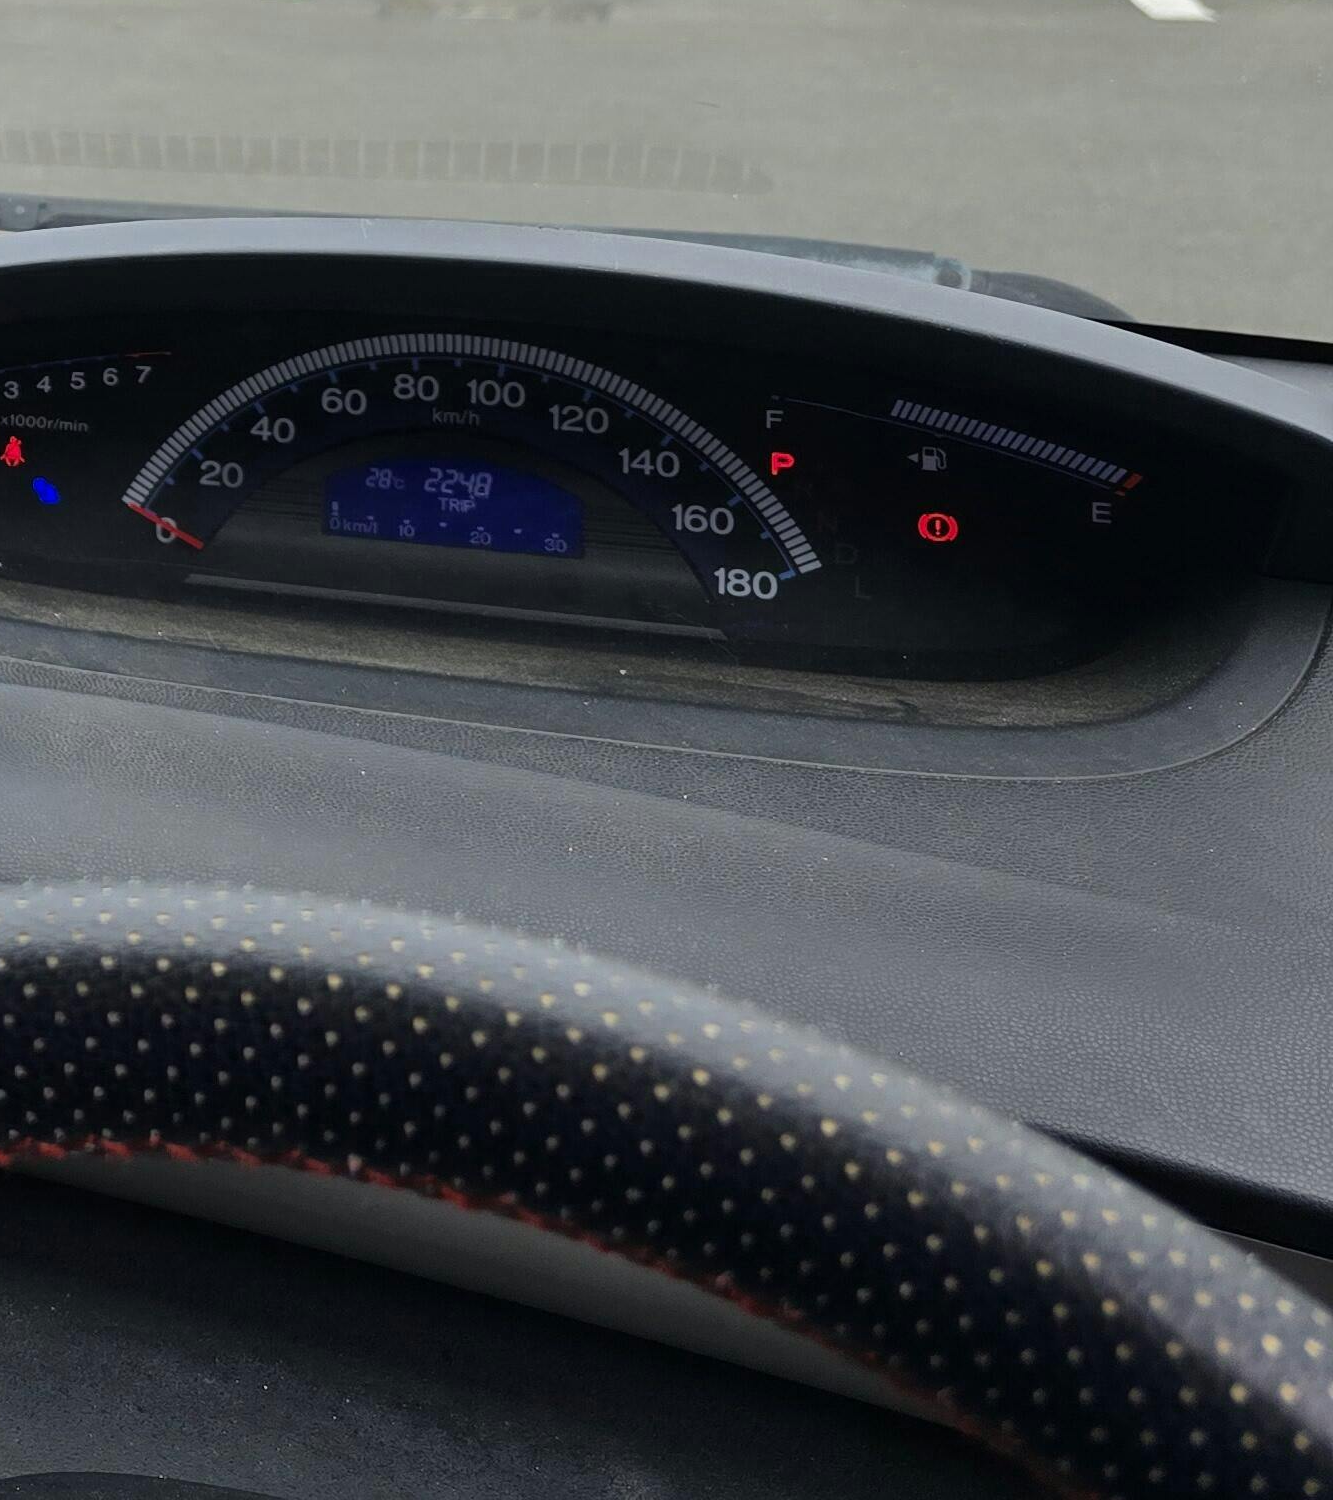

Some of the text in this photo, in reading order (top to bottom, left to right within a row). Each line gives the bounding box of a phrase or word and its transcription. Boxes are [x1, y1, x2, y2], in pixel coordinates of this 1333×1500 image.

[3, 381, 20, 399] 3
[36, 375, 52, 393] 4
[70, 371, 86, 390] 5
[102, 367, 119, 387] 6
[135, 365, 151, 384] 7
[393, 374, 439, 401] 80
[466, 379, 526, 408] 100
[321, 387, 367, 415] 60
[250, 416, 295, 443] 40
[432, 407, 480, 427] km/h
[548, 403, 609, 434] 120
[765, 409, 784, 429] F
[199, 460, 244, 488] 20
[619, 448, 680, 478] 140
[771, 451, 795, 476] P
[437, 496, 476, 512] TRIP
[1091, 501, 1112, 524] E
[155, 516, 177, 543] 0
[671, 503, 734, 536] 160
[329, 517, 568, 553] 0 km/l 10 20 30
[713, 567, 779, 600] 180
